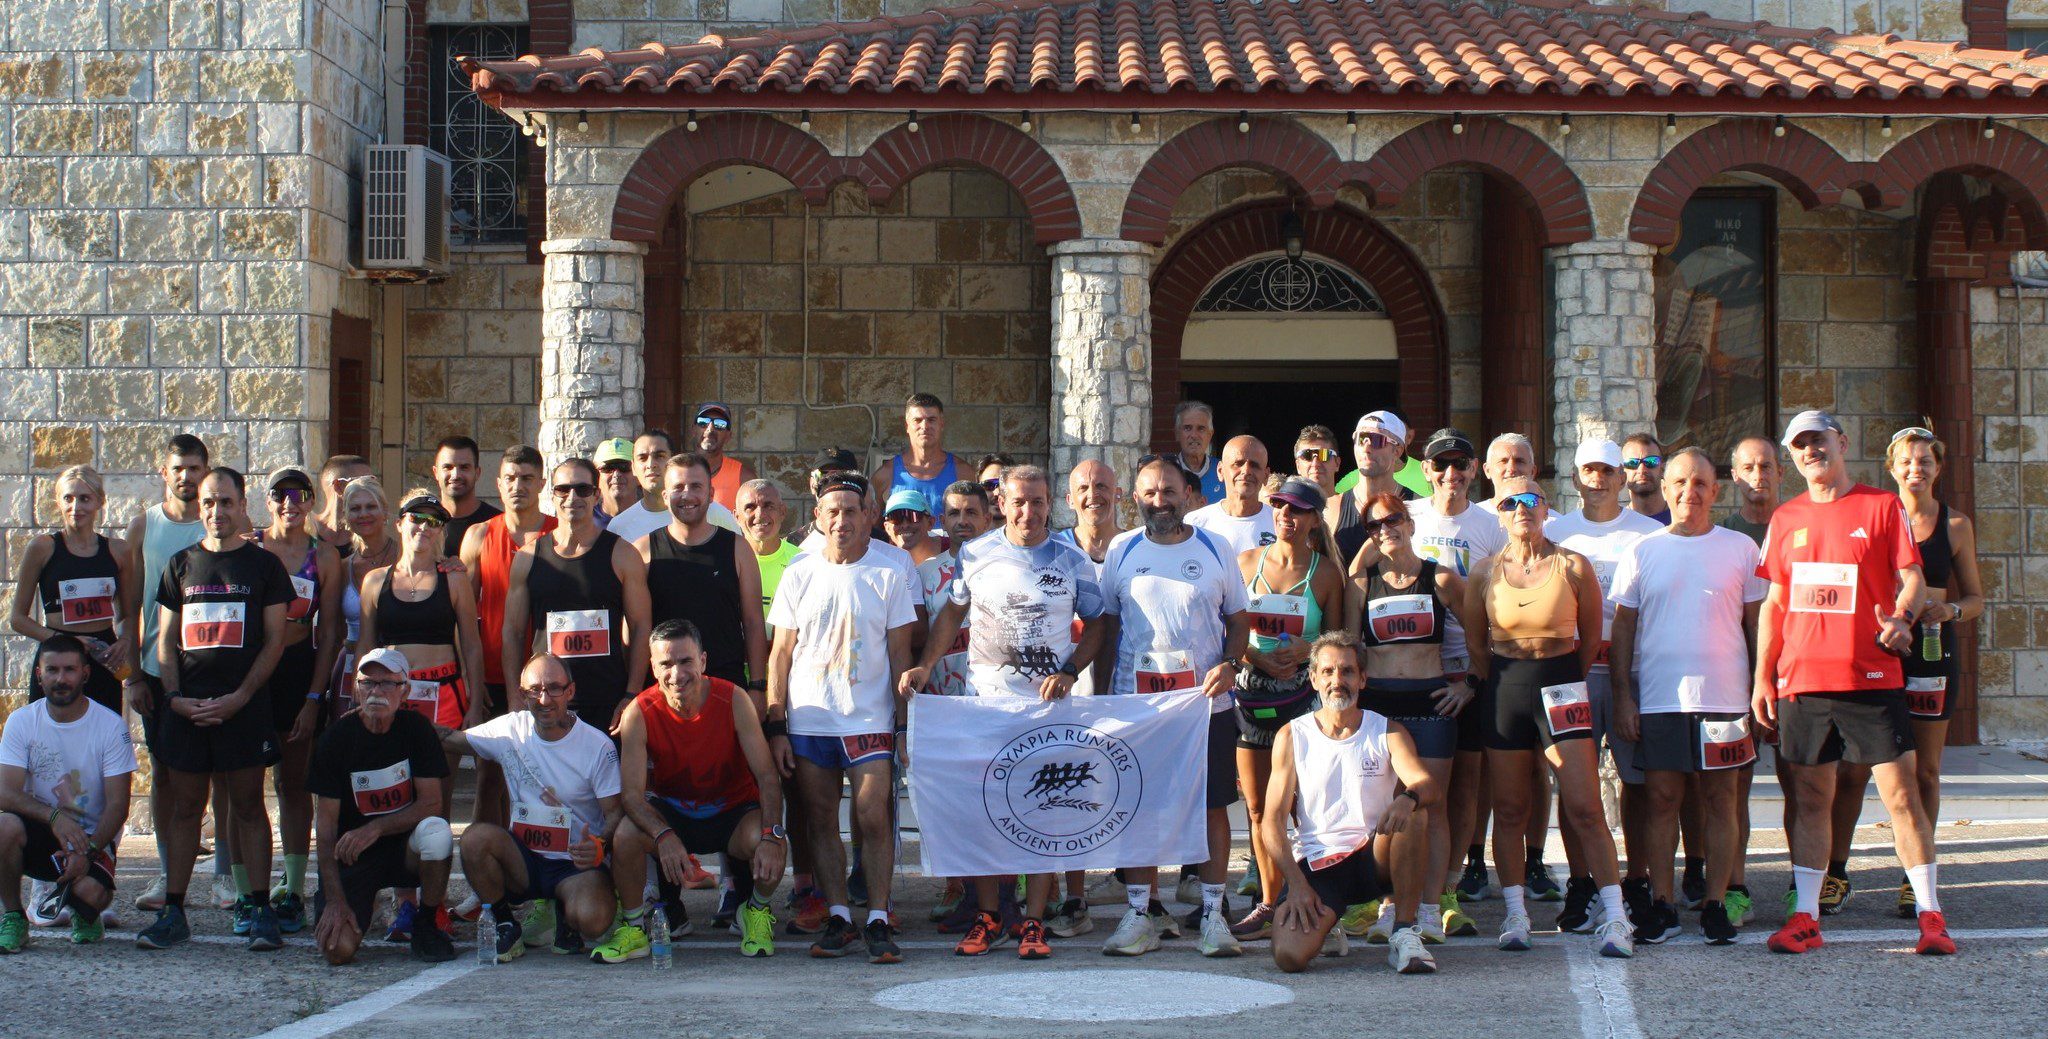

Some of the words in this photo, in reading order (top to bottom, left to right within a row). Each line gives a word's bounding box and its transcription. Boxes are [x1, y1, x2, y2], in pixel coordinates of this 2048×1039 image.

[1422, 536, 1470, 549] STEREA
[1806, 588, 1839, 607] 050
[1257, 616, 1285, 633] 041
[1386, 617, 1417, 636] 006
[564, 634, 593, 651] 005
[1150, 676, 1176, 692] 012
[1866, 671, 1884, 679] ERGO
[1907, 695, 1937, 711] 046
[1565, 705, 1591, 725] 023
[993, 730, 1058, 780] OLYMPIA
[1065, 729, 1132, 772] RUNNERS
[1720, 745, 1747, 765] 015
[370, 789, 401, 809] 049
[524, 829, 551, 848] 008
[998, 816, 1062, 852] ANCIENT
[1066, 810, 1128, 851] OLYMPIA
